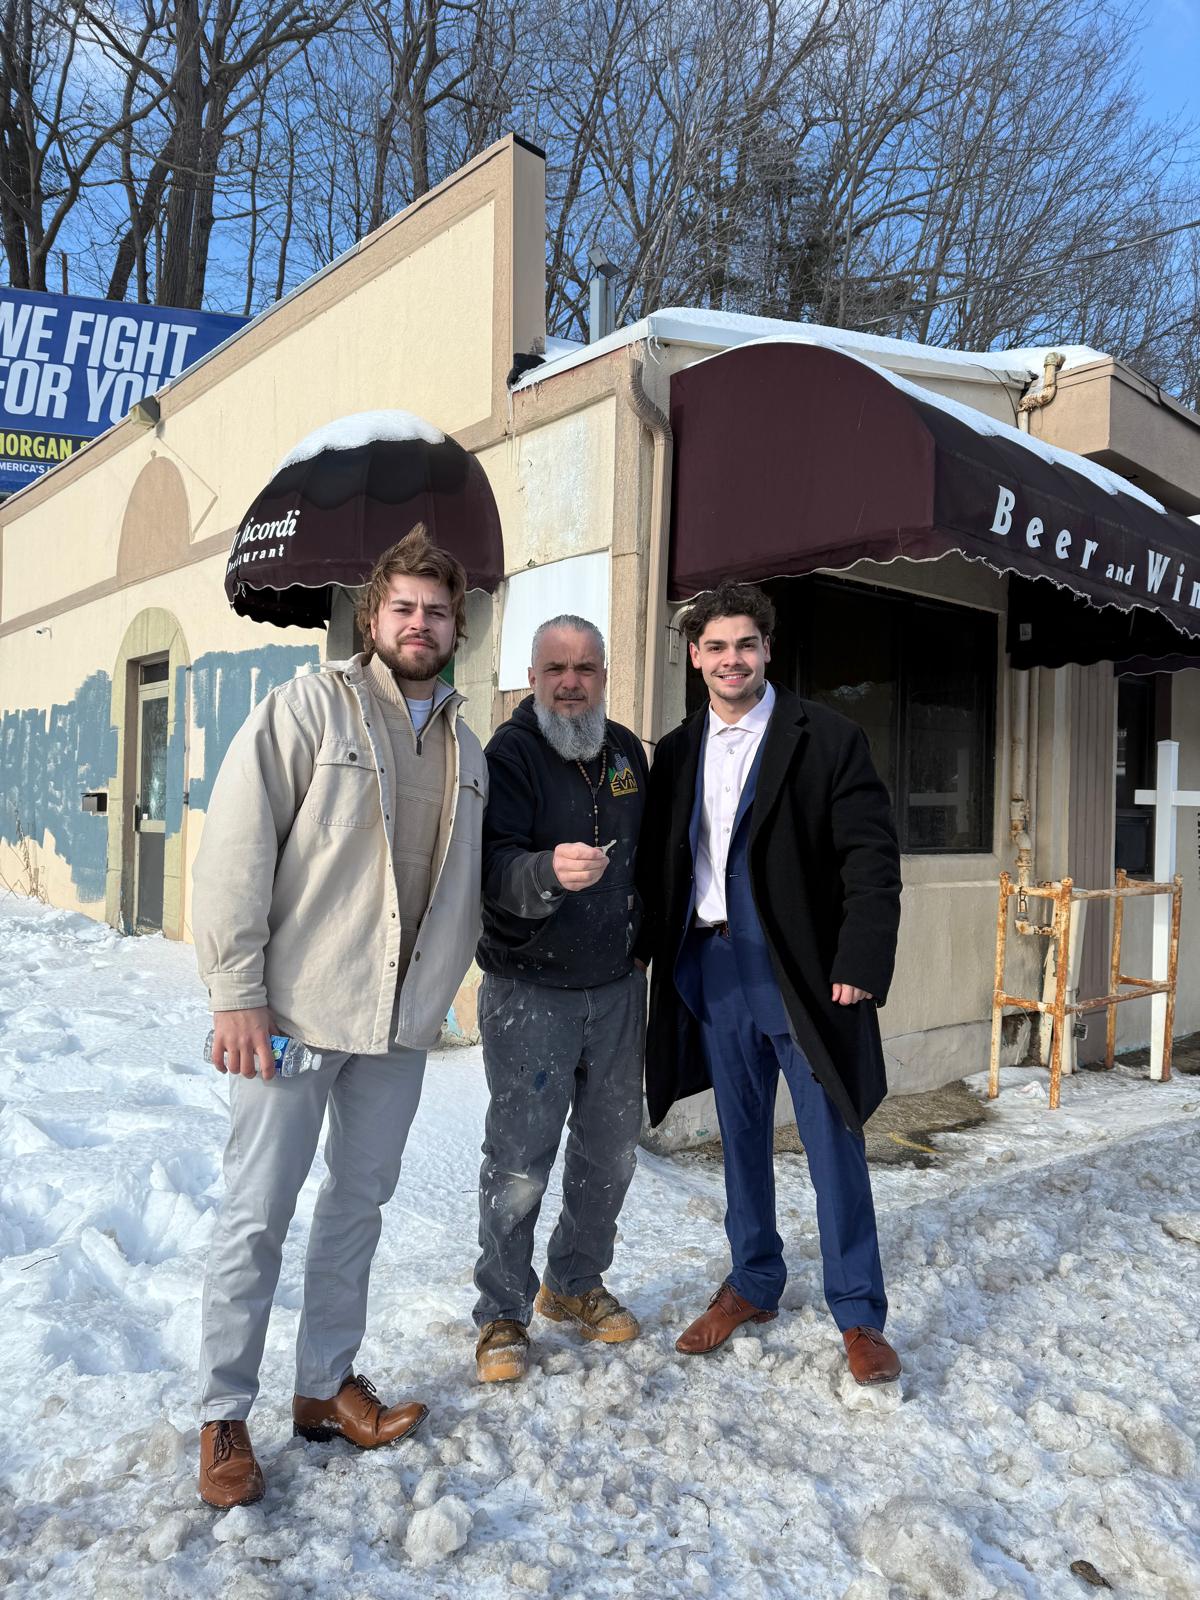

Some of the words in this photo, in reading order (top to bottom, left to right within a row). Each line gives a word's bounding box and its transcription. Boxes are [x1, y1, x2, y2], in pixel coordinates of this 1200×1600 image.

[0, 301, 58, 361] WE
[63, 310, 197, 376] FIGHT
[0, 432, 72, 460] ORGAN
[990, 485, 1099, 569] Beer
[1105, 563, 1135, 585] and
